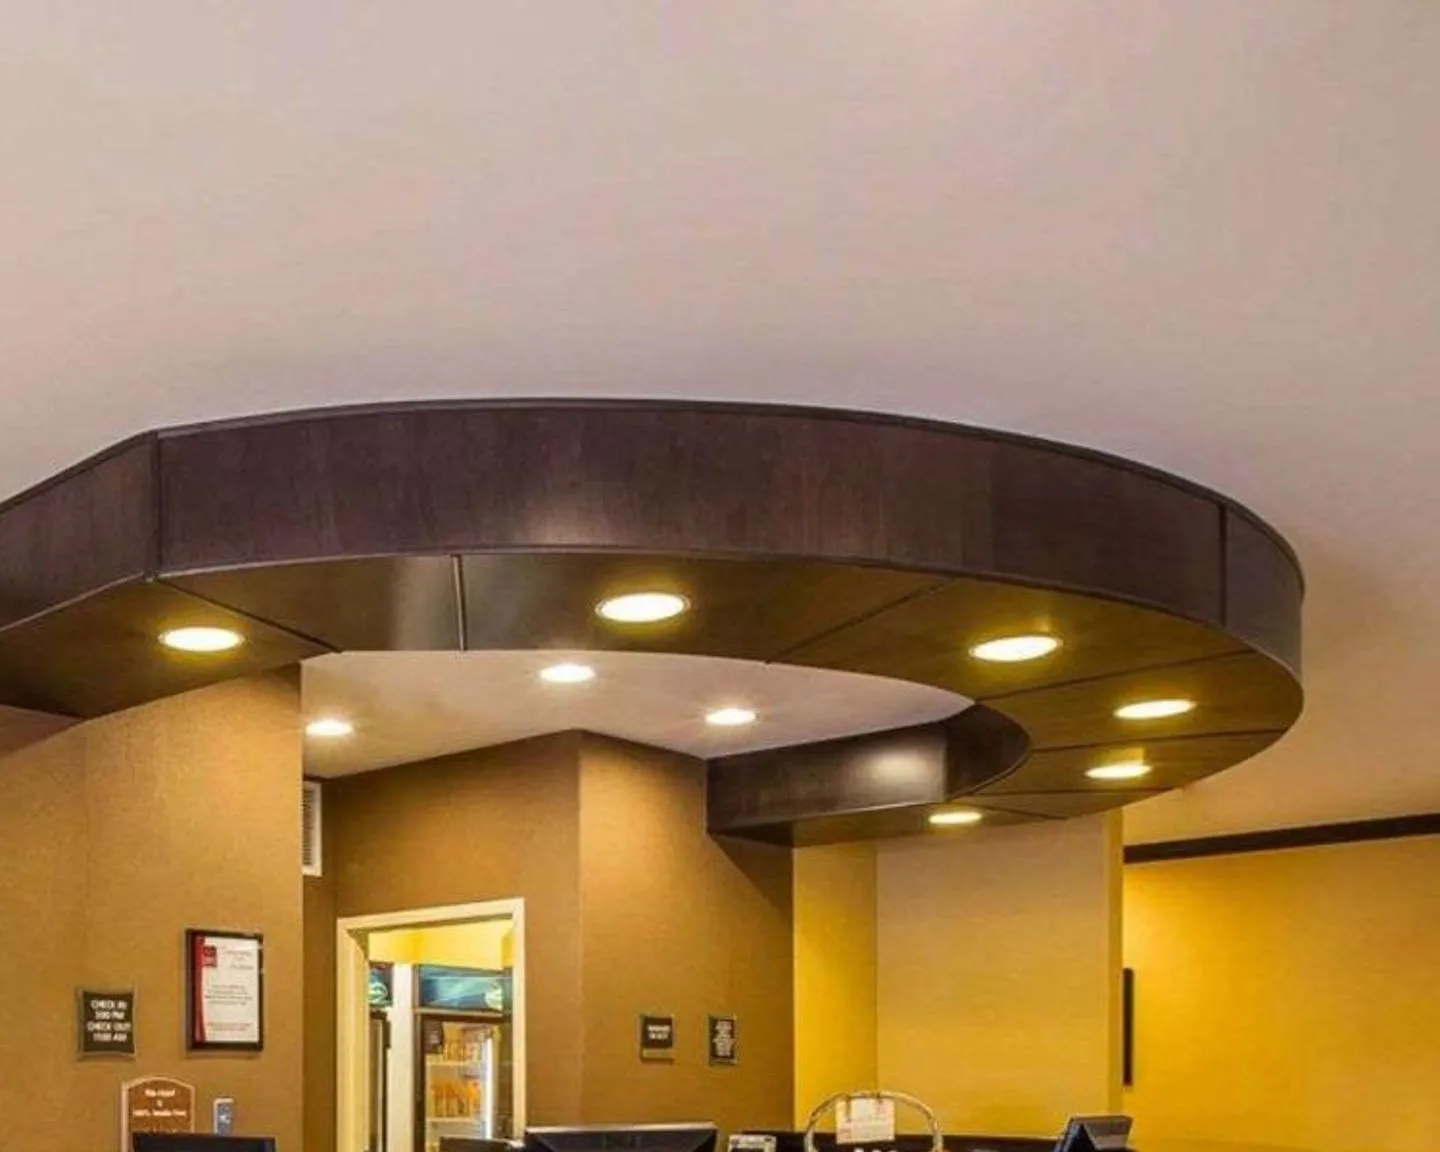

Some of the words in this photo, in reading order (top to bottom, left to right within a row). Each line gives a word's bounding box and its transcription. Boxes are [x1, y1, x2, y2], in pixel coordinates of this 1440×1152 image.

[91, 1000, 115, 1009] CHECK
[117, 1001, 127, 1009] IN
[87, 1021, 111, 1031] CHECK
[113, 1022, 131, 1031] OUT
